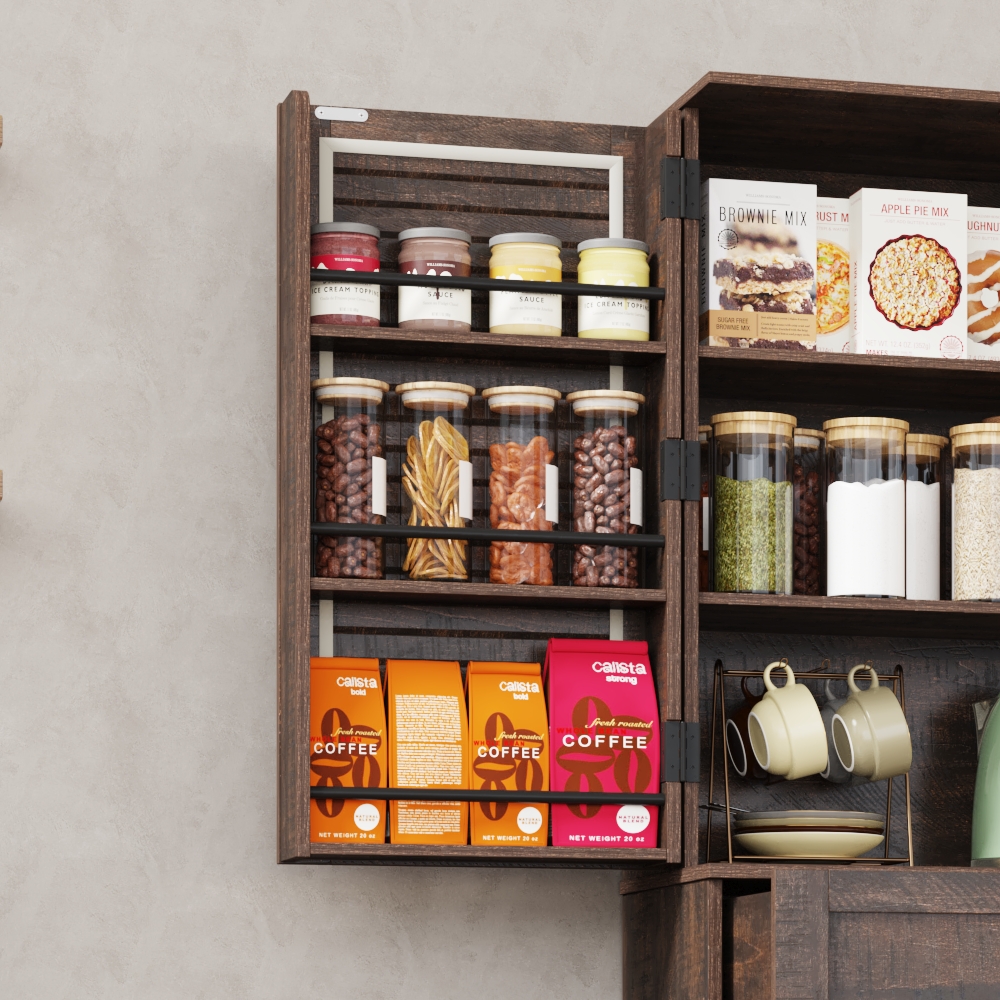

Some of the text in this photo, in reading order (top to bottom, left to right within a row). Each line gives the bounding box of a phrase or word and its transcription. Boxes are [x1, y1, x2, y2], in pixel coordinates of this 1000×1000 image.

[881, 204, 949, 217] APPLE PIE MIX
[719, 206, 807, 226] BROWNIE MIX
[816, 211, 838, 222] RUST
[311, 287, 321, 295] ICE
[427, 291, 454, 299] SAUCE
[519, 296, 545, 304] SAUCE
[716, 323, 740, 331] BROWNIE
[605, 675, 638, 685] strong
[350, 688, 366, 696] bold
[512, 692, 529, 700] bold
[585, 717, 654, 728] fresh roasted
[330, 727, 382, 737] fresh roasted
[494, 731, 517, 741] fresh
[556, 727, 594, 735] WHOLE
[310, 735, 337, 743] WHOLE
[562, 734, 648, 749] COFFEE
[313, 742, 378, 755] COFFEE
[477, 746, 540, 759] COFFEE
